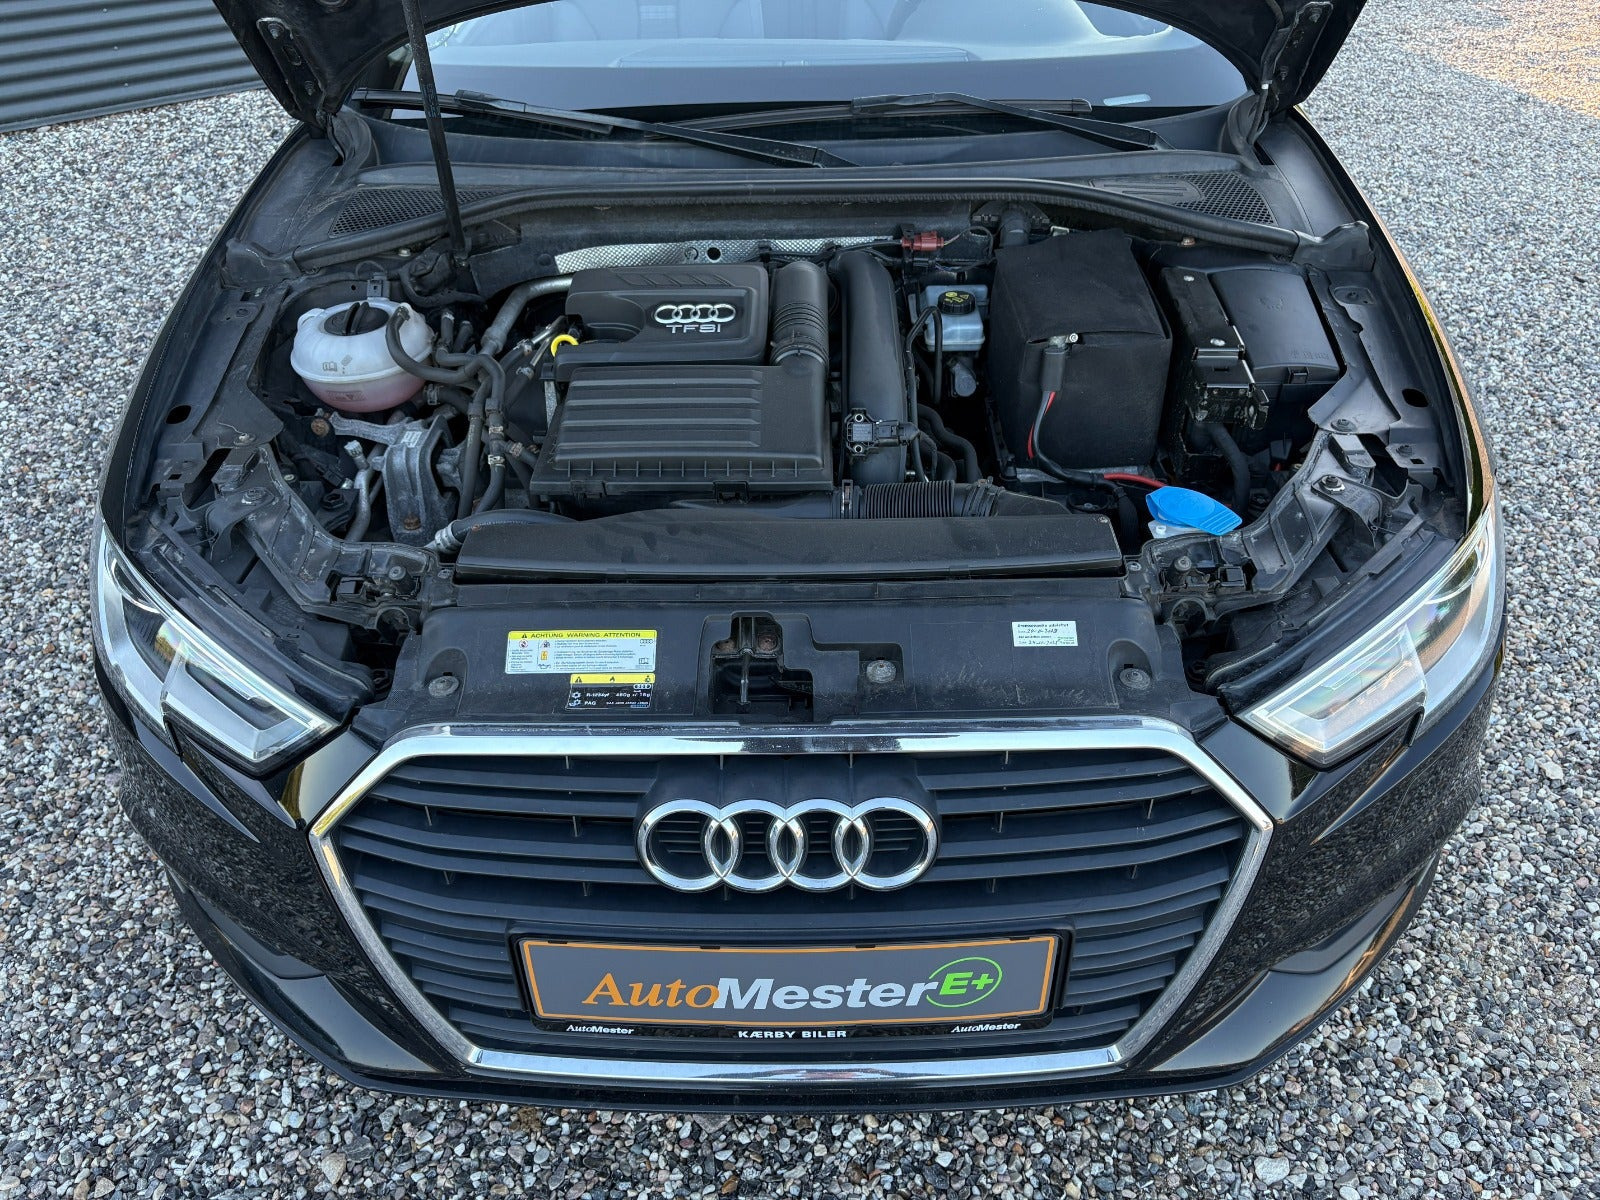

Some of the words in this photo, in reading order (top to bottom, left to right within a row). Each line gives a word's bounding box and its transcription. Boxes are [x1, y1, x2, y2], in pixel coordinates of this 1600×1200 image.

[665, 324, 721, 334] TFSI
[582, 972, 939, 1010] AutoMester
[939, 971, 994, 996] E+
[566, 1024, 635, 1035] AutoMester
[951, 1022, 1021, 1034] AutoMester
[738, 1030, 796, 1039] KÆRBY
[801, 1030, 848, 1039] BILER
